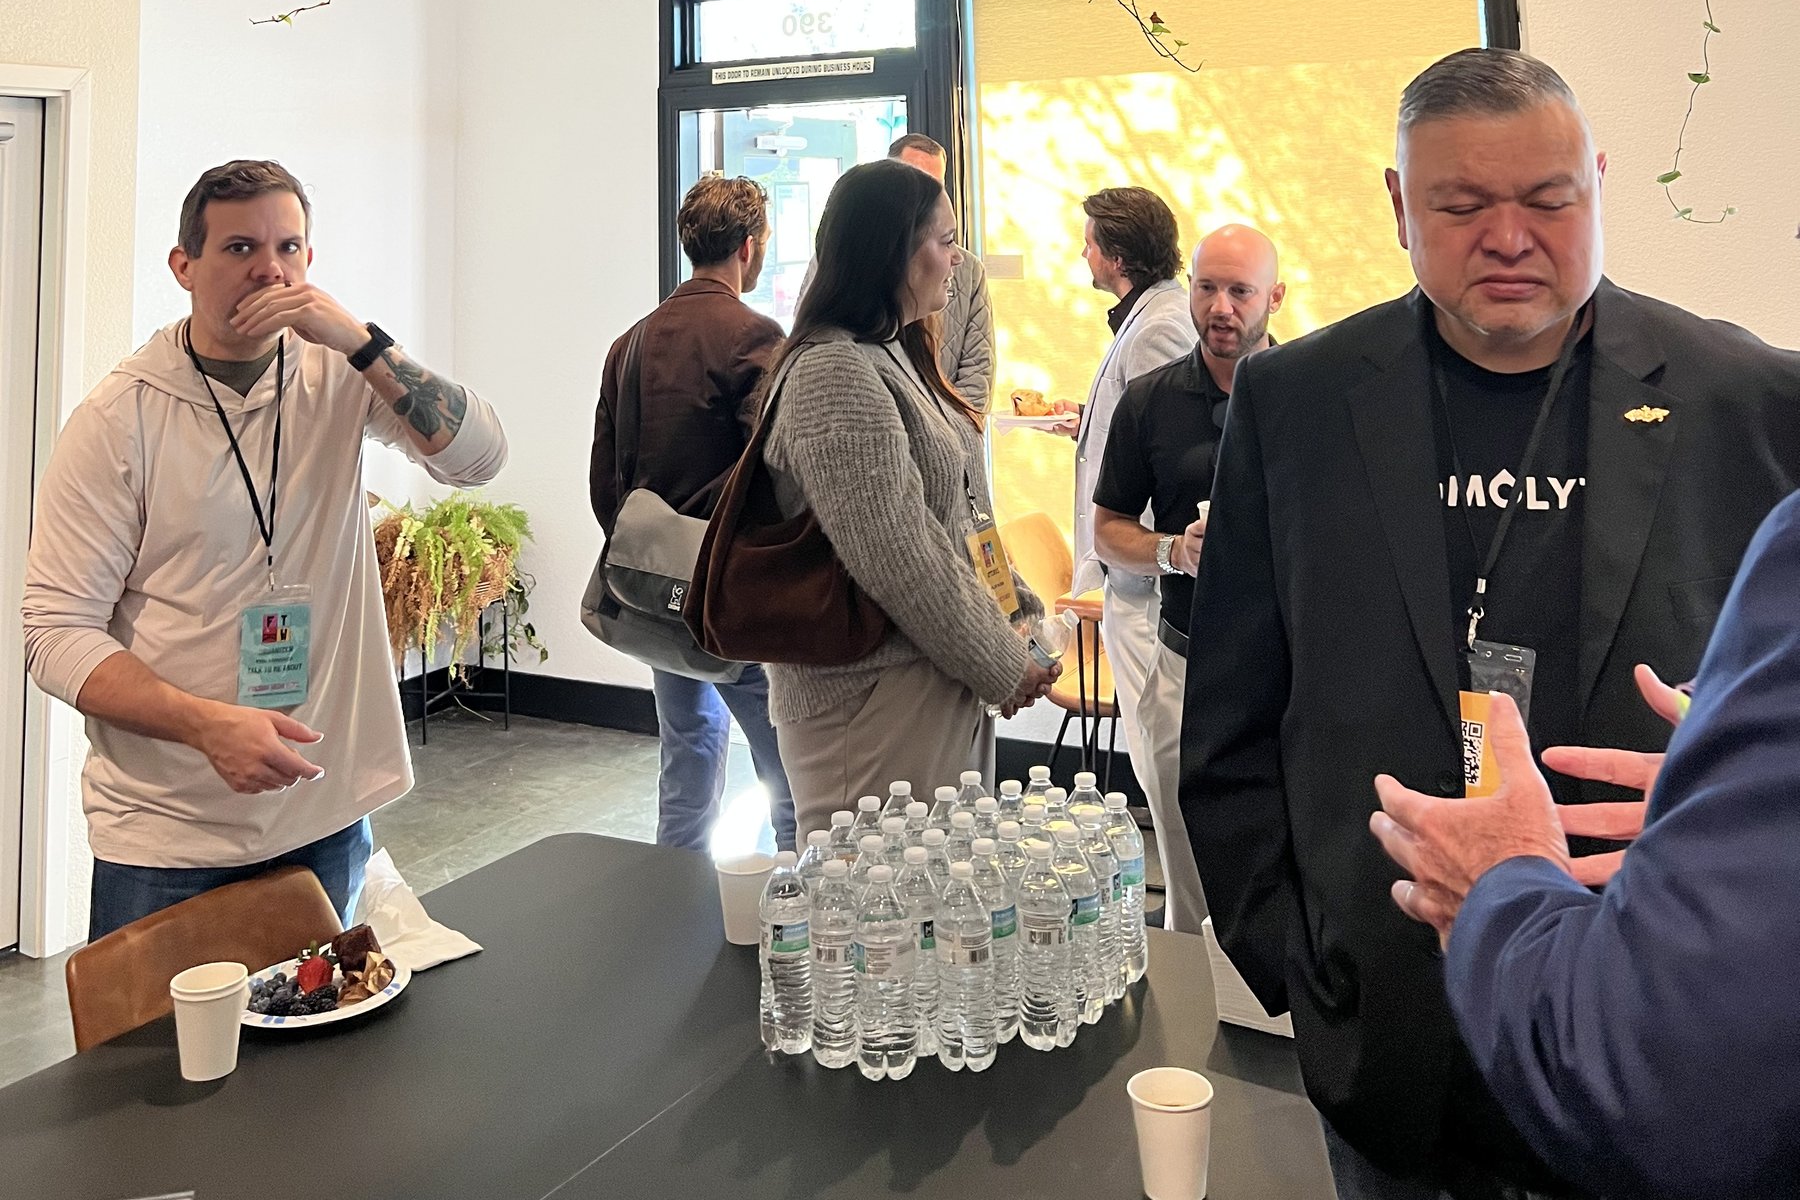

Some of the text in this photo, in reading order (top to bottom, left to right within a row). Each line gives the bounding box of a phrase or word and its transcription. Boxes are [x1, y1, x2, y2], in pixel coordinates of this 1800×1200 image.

[715, 61, 871, 80] THIS DOOR TO REMAIN UNLOCKED DURING BUSINESS HOURS
